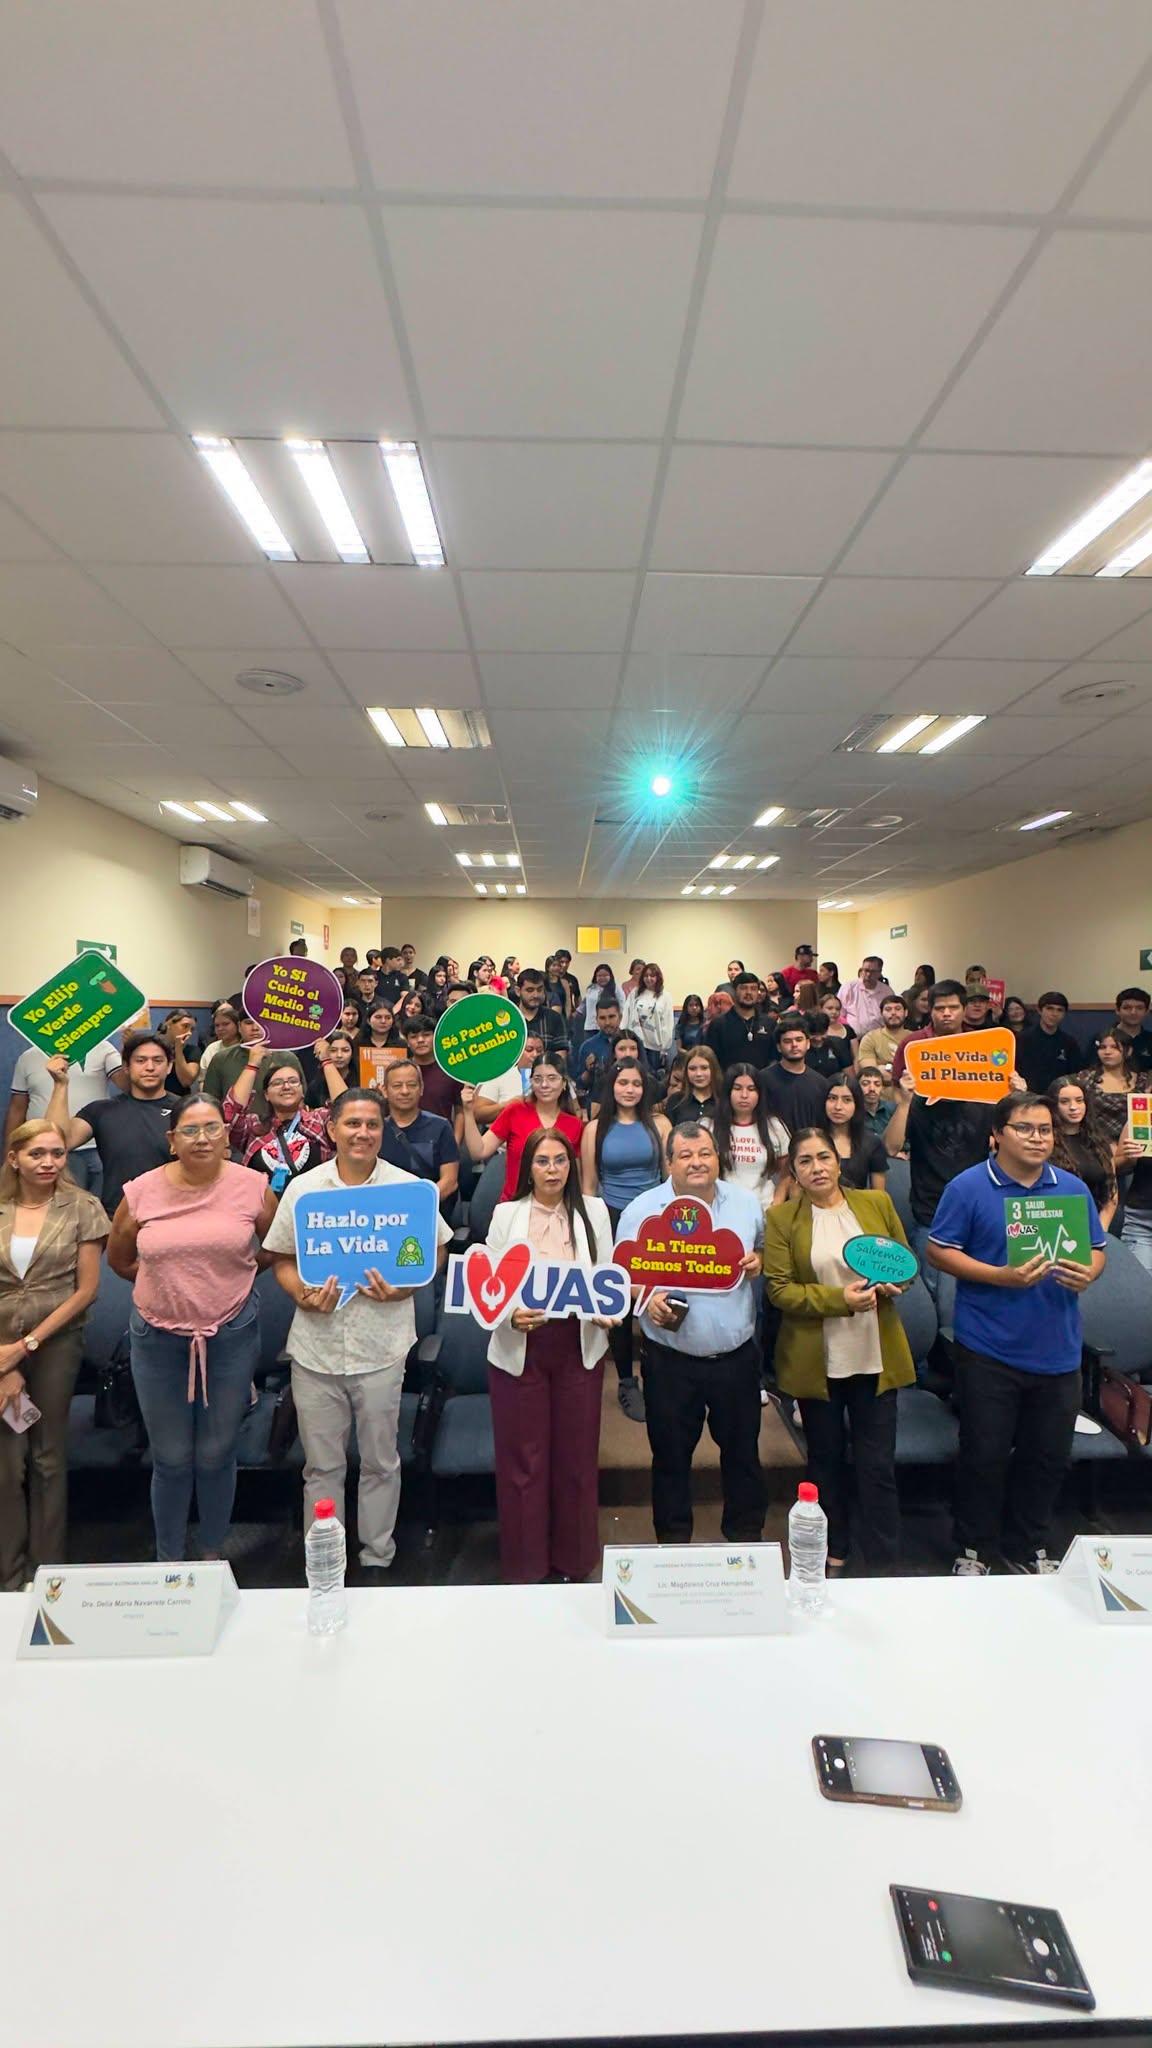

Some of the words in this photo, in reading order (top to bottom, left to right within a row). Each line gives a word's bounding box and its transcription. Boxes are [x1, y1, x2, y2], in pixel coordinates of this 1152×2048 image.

[272, 964, 288, 977] Yo
[290, 968, 307, 982] SI
[268, 979, 305, 997] Cuido
[307, 990, 320, 1001] el
[23, 1008, 46, 1024] Yo
[42, 981, 79, 1010] Elijo
[263, 993, 304, 1012] Medio
[38, 1002, 83, 1037] Verde
[53, 1004, 113, 1053] Siempre
[259, 1008, 321, 1031] Ambiente
[441, 1034, 459, 1050] Sé
[459, 1021, 493, 1042] Parte
[447, 1047, 468, 1066] del
[468, 1029, 518, 1056] Cambio
[920, 1051, 951, 1061] Dale
[955, 1052, 987, 1062] Vida
[920, 1068, 936, 1080] al
[941, 1068, 1005, 1082] Planeta
[1012, 1201, 1022, 1220] 3
[1025, 1200, 1045, 1210] SALUD
[1031, 1209, 1063, 1219] BIENESTAR
[306, 1210, 369, 1229] Hazlo
[373, 1213, 409, 1231] por
[305, 1238, 333, 1255] La
[338, 1235, 389, 1254] Vida
[646, 1238, 666, 1253] La
[669, 1239, 717, 1255] Tierra
[856, 1242, 906, 1263] Salvemos
[630, 1256, 682, 1272] Somos
[685, 1260, 732, 1275] Todos
[856, 1256, 867, 1267] la
[871, 1261, 905, 1277] Tierra
[704, 1580, 720, 1588] Cruz
[81, 1600, 94, 1608] Dra.
